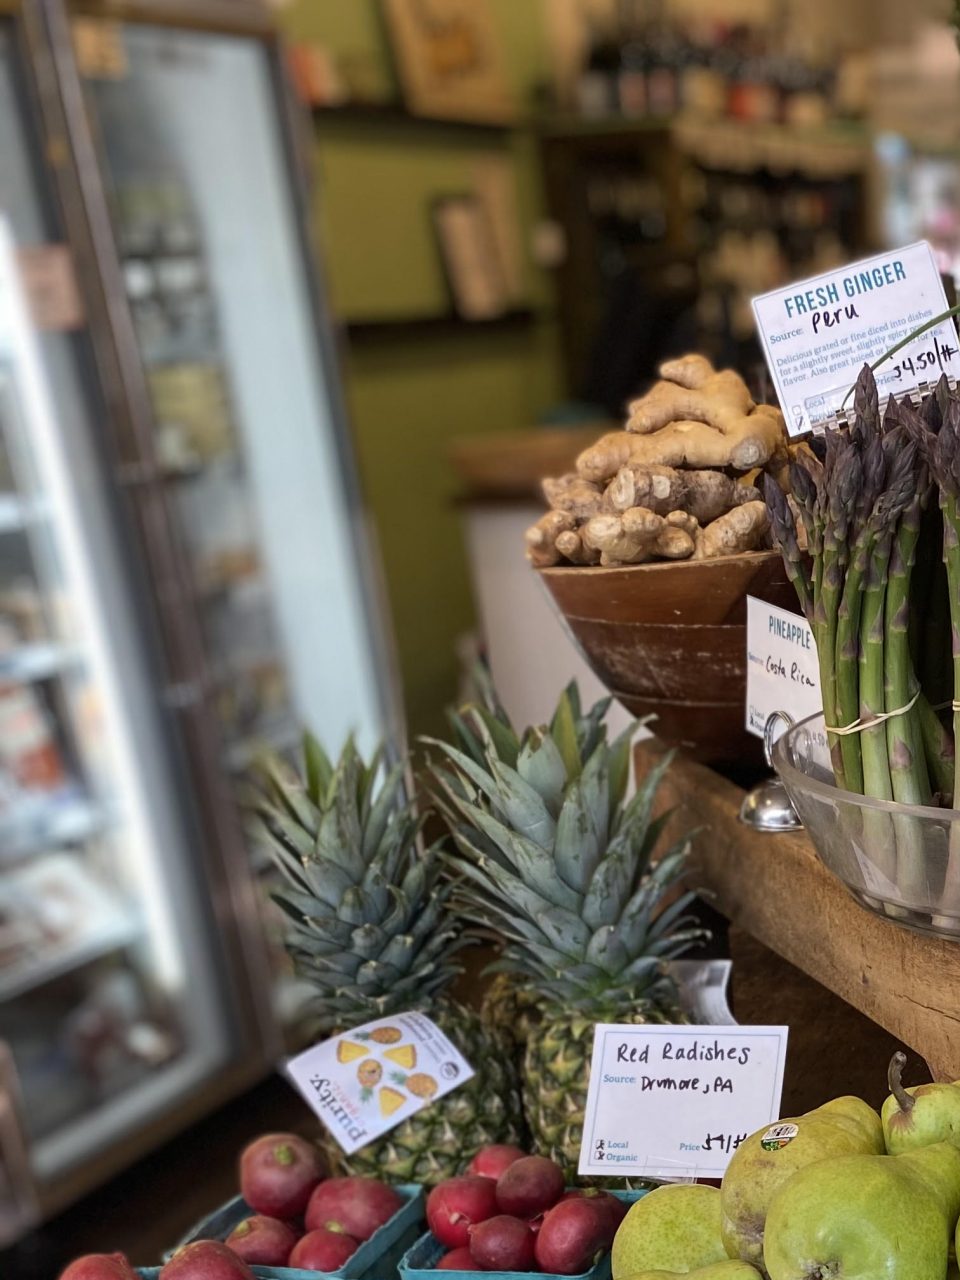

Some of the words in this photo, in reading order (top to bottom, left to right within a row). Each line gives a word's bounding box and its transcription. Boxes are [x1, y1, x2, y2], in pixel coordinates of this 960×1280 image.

[784, 282, 840, 318] FRESH
[843, 261, 907, 298] GINGER
[769, 328, 803, 345] Source:
[777, 349, 813, 367] Delicious
[814, 341, 840, 356] grated
[850, 329, 868, 341] fine
[867, 323, 889, 336] diced
[890, 317, 907, 330] into
[907, 309, 933, 324] dishes
[779, 367, 792, 377] for
[800, 353, 829, 373] slightly
[830, 347, 857, 361] sweet,
[857, 334, 886, 353] slightly
[887, 328, 909, 344] spicy
[782, 374, 809, 388] flavor.
[810, 366, 827, 379] Also
[828, 359, 850, 374] great
[850, 350, 874, 367] juiced
[768, 614, 811, 650] PINEAPPLE
[765, 654, 787, 679] Costa
[790, 661, 816, 687] Rica
[616, 1042, 650, 1065] Red
[661, 1039, 751, 1065] Radishes
[603, 1073, 636, 1084] Source:
[713, 1075, 734, 1094] PA
[606, 1152, 638, 1163] Organic
[607, 1140, 629, 1150] Local
[679, 1142, 700, 1152] Price
